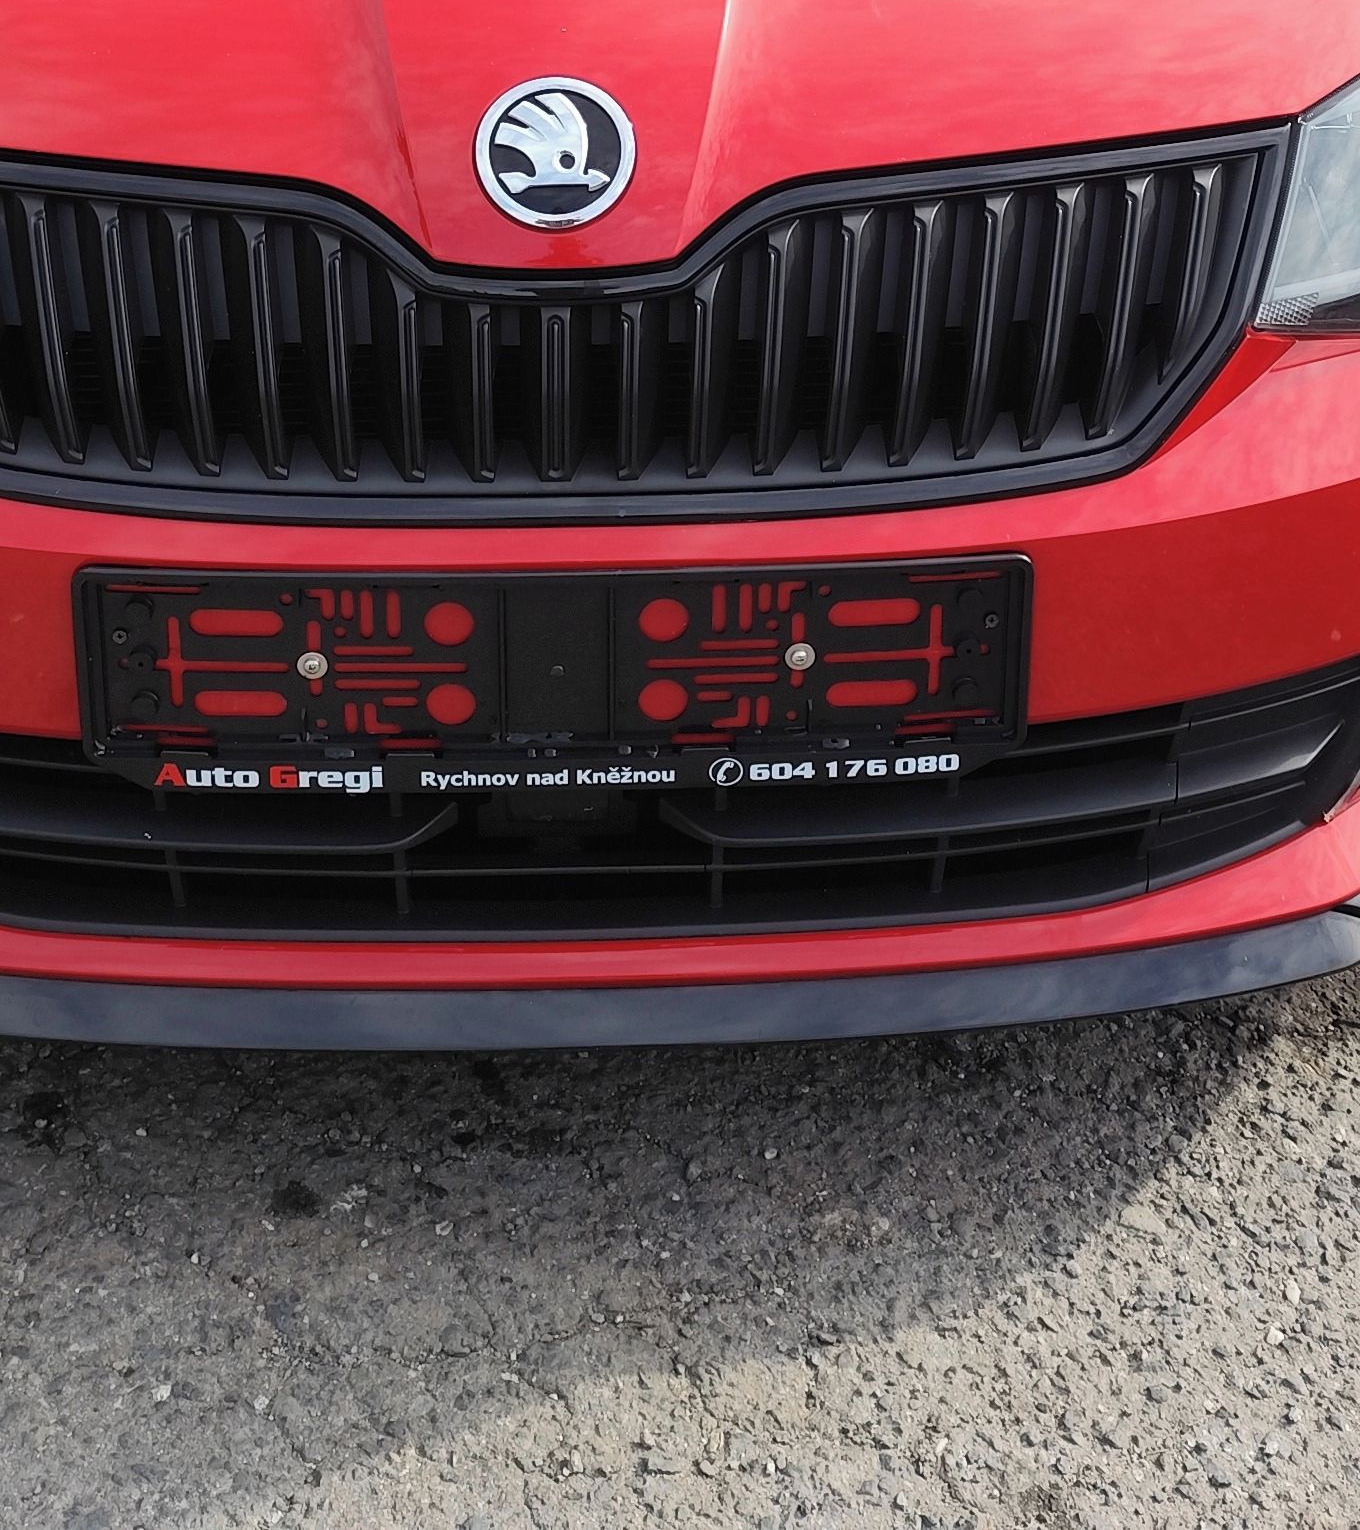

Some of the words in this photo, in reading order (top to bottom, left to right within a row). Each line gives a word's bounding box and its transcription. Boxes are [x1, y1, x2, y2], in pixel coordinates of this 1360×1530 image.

[154, 763, 260, 788] Auto
[269, 765, 384, 793] Gregi
[420, 770, 519, 790] Rychnov
[526, 769, 569, 786] nad
[576, 766, 676, 785] Kněžnou
[749, 761, 816, 781] 604
[825, 758, 888, 778] 176
[894, 753, 960, 775] 080
